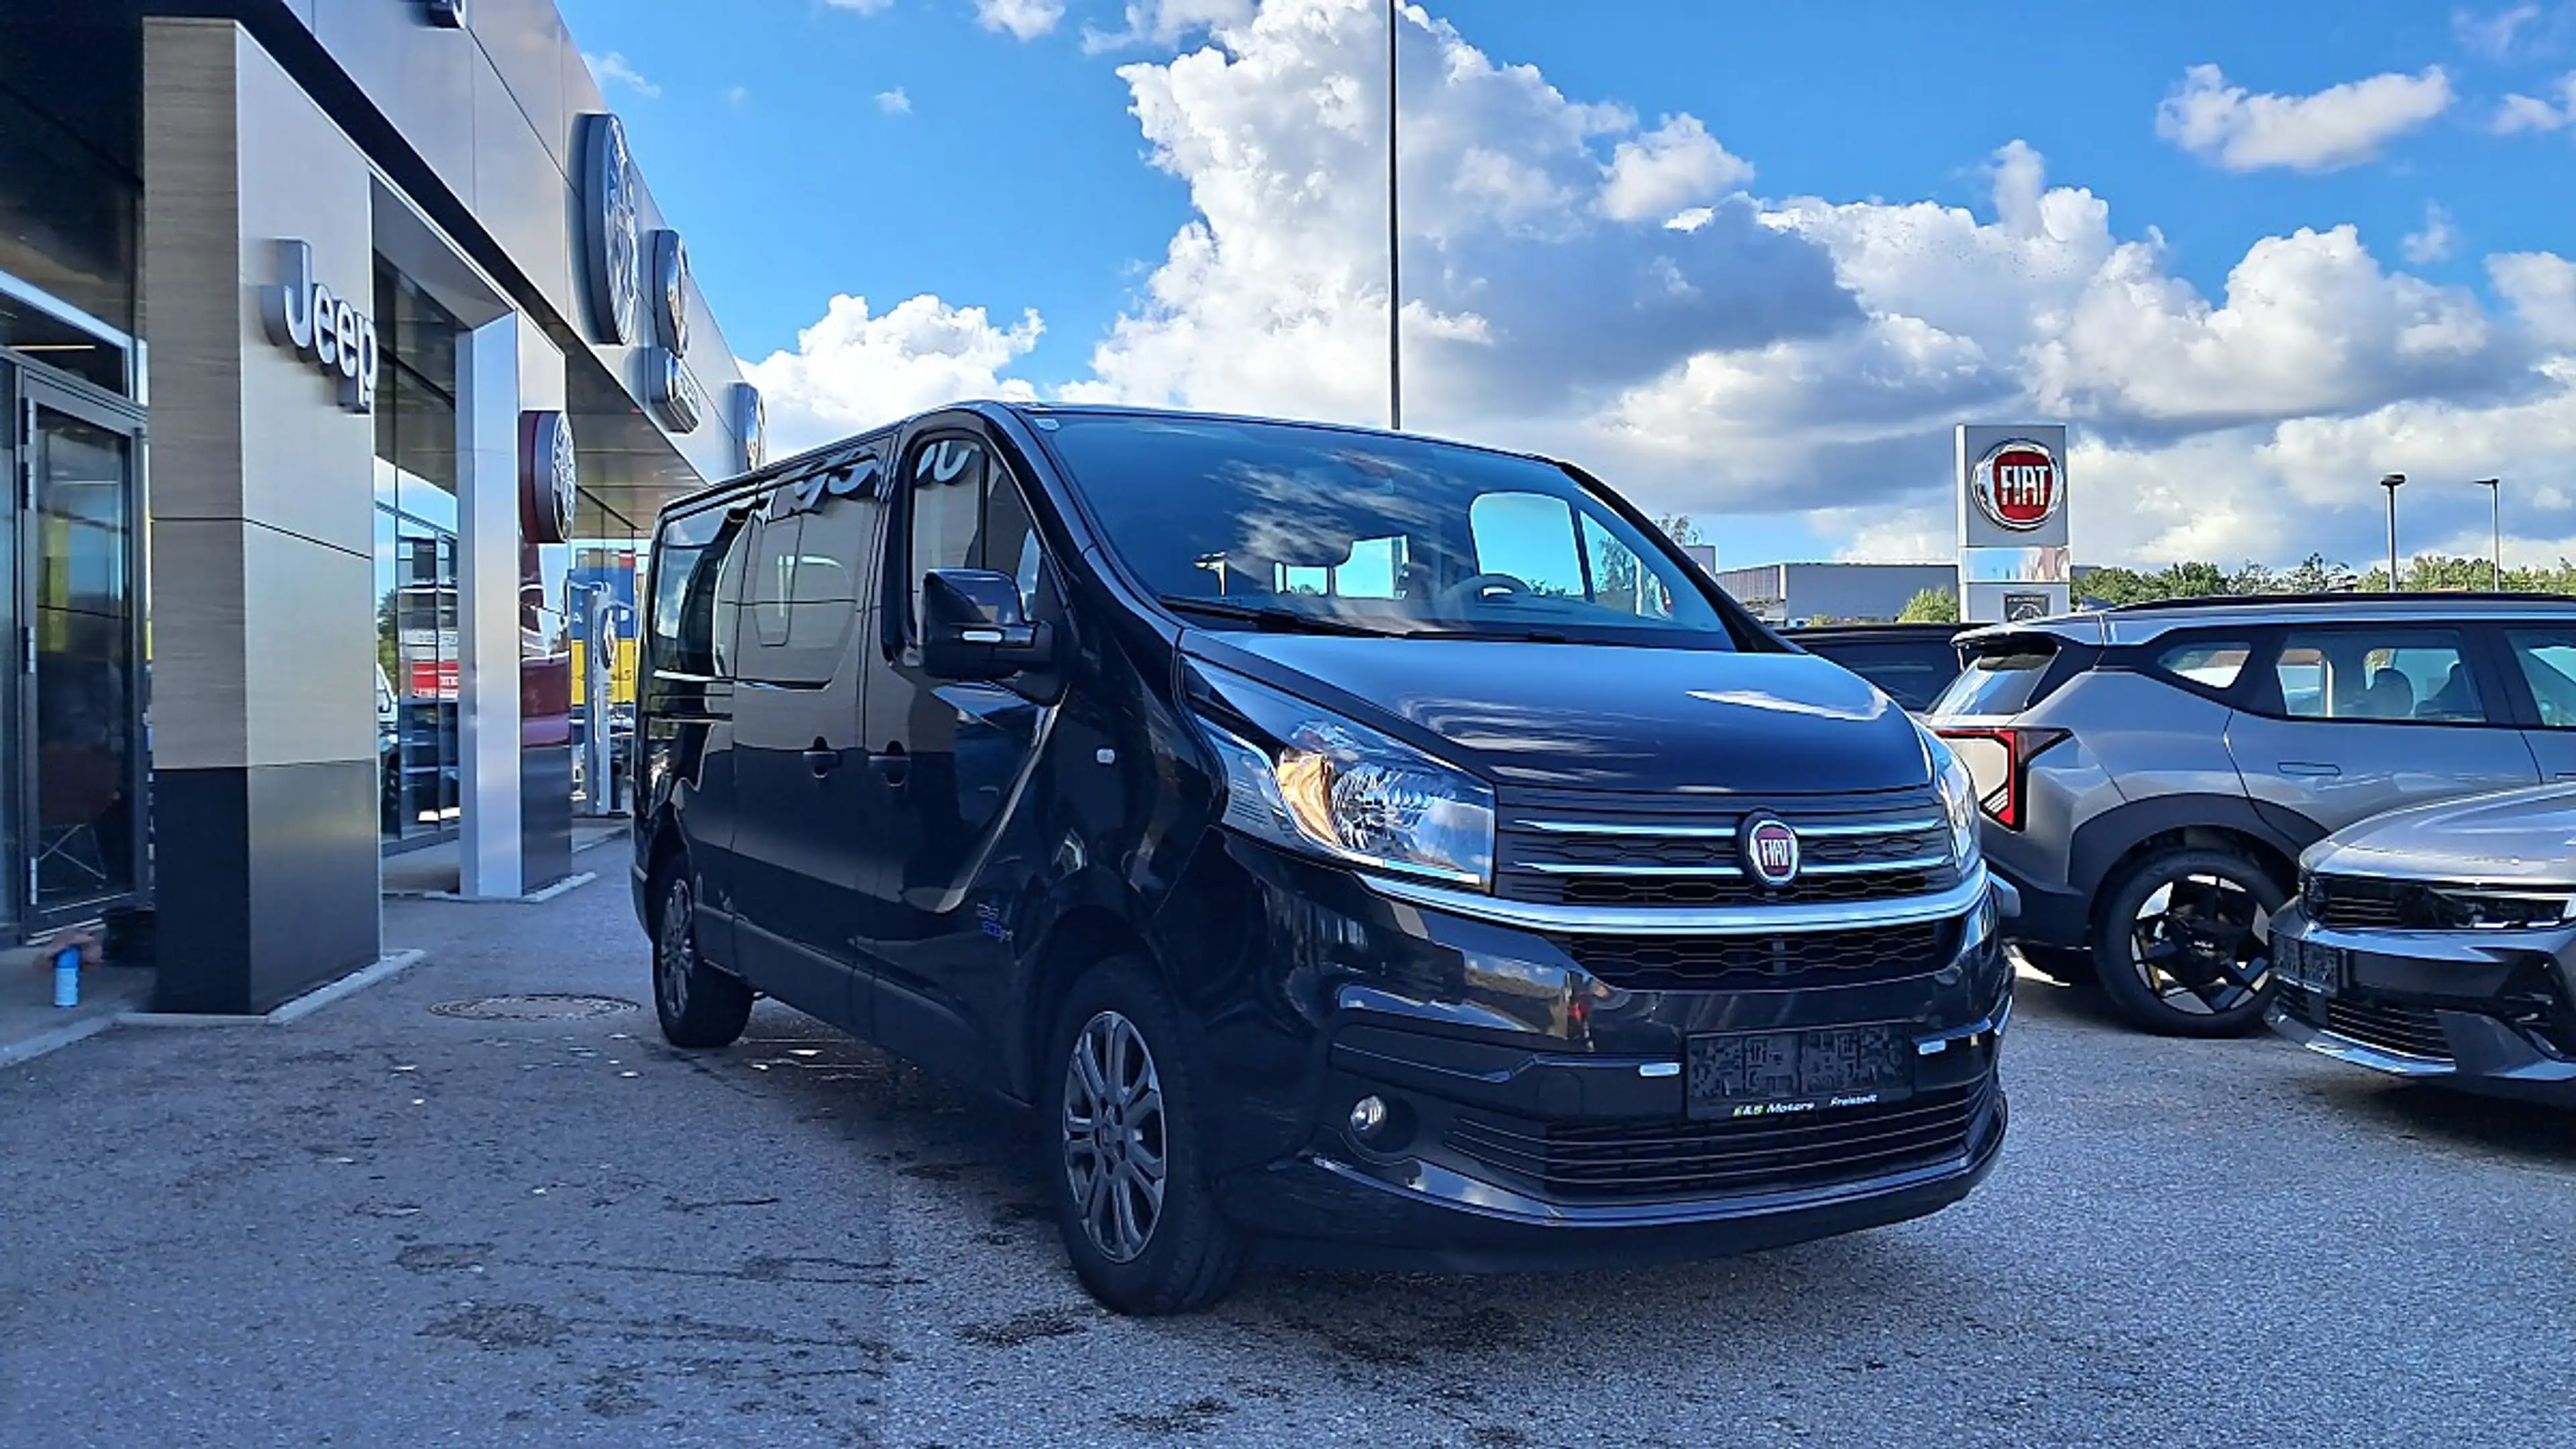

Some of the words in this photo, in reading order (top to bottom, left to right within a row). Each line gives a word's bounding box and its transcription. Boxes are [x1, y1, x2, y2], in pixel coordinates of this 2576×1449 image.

[276, 238, 378, 408] Jeep
[2000, 465, 2049, 506] FIAT
[1760, 838, 1790, 867] FIAT
[1766, 1102, 1815, 1114] Motors
[1829, 1094, 1878, 1107] Freistadt
